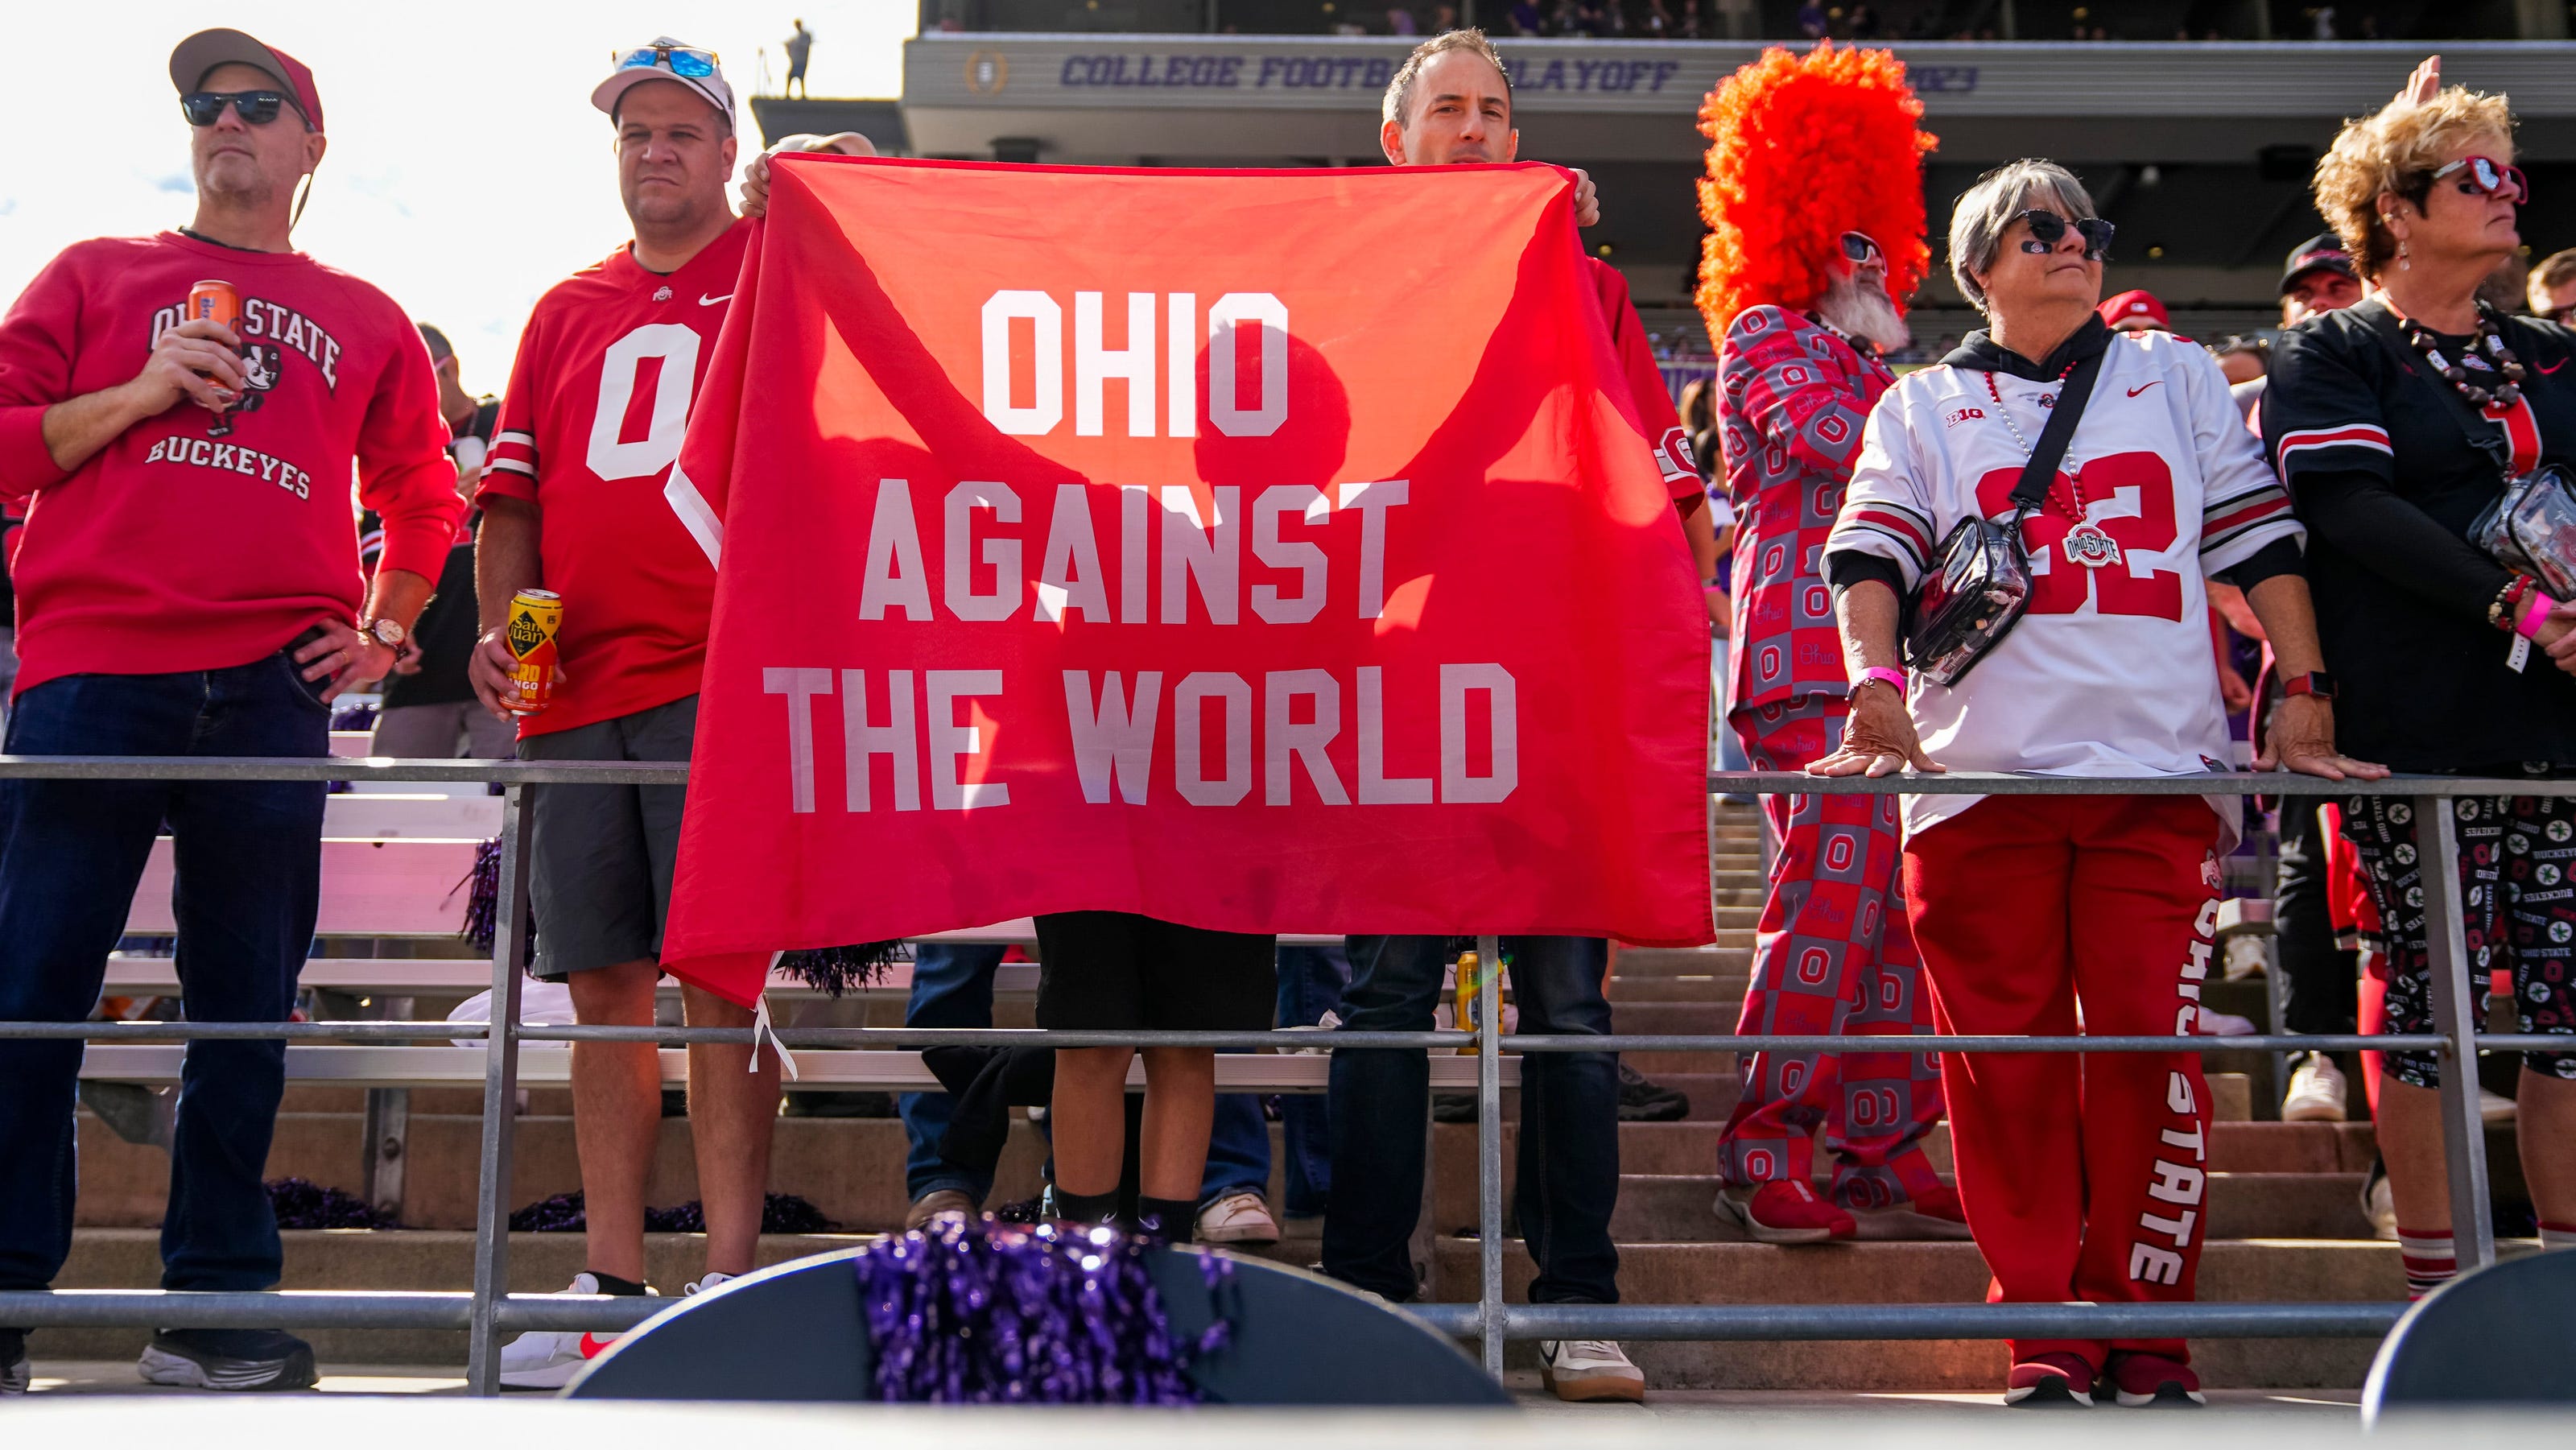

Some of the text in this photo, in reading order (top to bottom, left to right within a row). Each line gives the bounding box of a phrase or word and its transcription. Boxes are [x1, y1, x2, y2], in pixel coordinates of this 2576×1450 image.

[1061, 56, 1245, 88] COLLEGE
[1256, 56, 1394, 88] FOOTB
[1504, 59, 1680, 91] LAYOFF
[244, 297, 343, 390] STATE
[981, 290, 1289, 437] OHIO
[145, 436, 312, 501] BUCKEYES
[859, 478, 1410, 626] AGAINST
[2067, 535, 2119, 560] OHIO STATE
[509, 623, 543, 642] Juan
[514, 616, 541, 632] San
[1799, 643, 1835, 666] Ohio
[763, 663, 1518, 813] THE WORLD
[2533, 848, 2576, 860] BUCKEY
[2523, 888, 2574, 903] BUCKEYES
[2129, 1071, 2206, 1286] STATE
